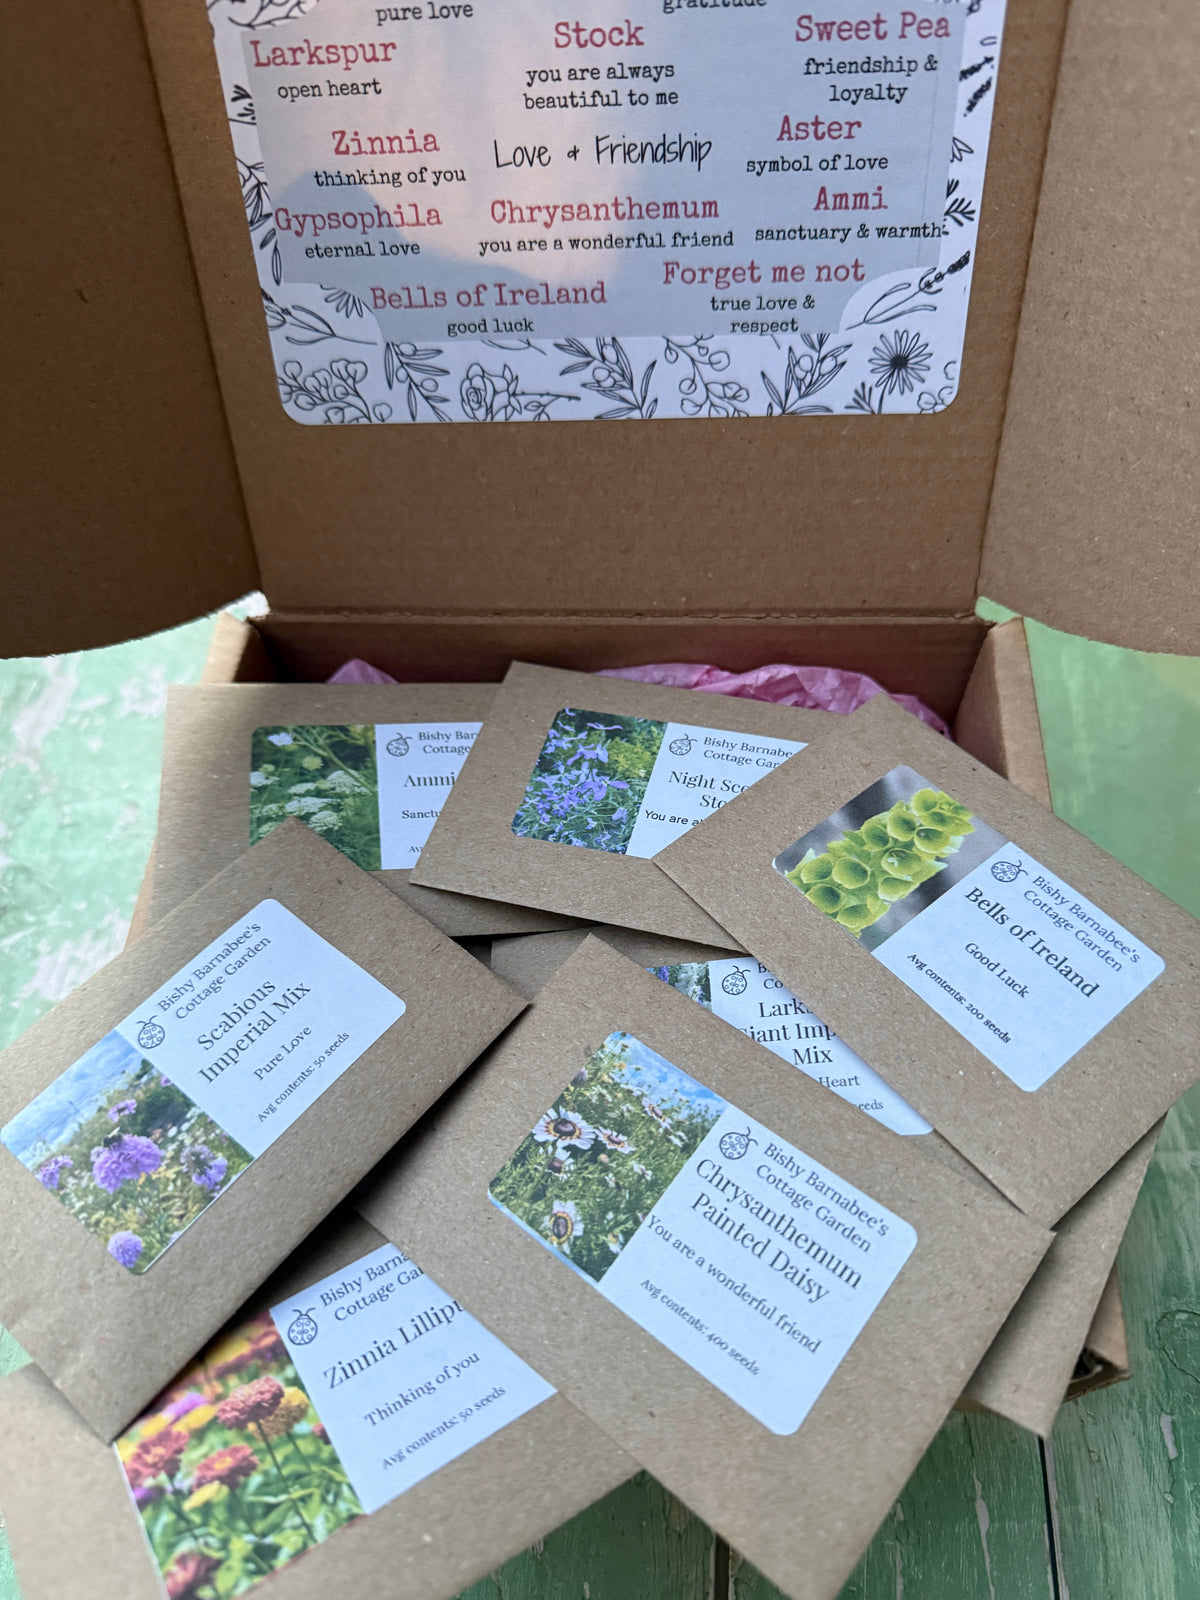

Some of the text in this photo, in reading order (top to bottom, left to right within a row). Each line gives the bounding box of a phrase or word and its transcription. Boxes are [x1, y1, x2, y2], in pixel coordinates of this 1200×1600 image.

[376, 2, 473, 25] pure love
[795, 11, 950, 42] Sweet Pea
[554, 20, 644, 49] Stock
[250, 39, 397, 70] Larkspur
[803, 55, 938, 76] friendship &
[277, 78, 382, 102] open heart
[525, 63, 675, 87] you are always
[524, 90, 679, 109] beautiful to me
[829, 84, 908, 104] loyalty
[332, 128, 440, 155] Zinnia
[776, 115, 862, 141] Aster
[493, 139, 551, 168] Love
[595, 133, 712, 171] Friendship
[746, 153, 889, 177] symbol of love
[314, 166, 466, 187] thinking of you
[491, 196, 720, 229] Chrysanthemum
[813, 185, 888, 212] Ammi
[274, 203, 443, 238] Gypsophila
[755, 222, 942, 243] sanctuary & warmth
[305, 241, 421, 259] eternal love
[478, 231, 734, 257] you are a wonderful friend
[662, 258, 865, 290] Forget me not
[370, 281, 607, 311] Bells of Ireland
[710, 295, 815, 311] true love &
[447, 317, 535, 336] good luck
[729, 318, 799, 335] respect
[419, 731, 451, 742] Bishy
[704, 737, 737, 750] Bishy
[704, 749, 752, 766] Cottage
[404, 772, 455, 787] Ammi
[668, 771, 715, 789] Night
[645, 810, 665, 821] You
[669, 815, 688, 824] are
[1023, 890, 1123, 972] Cottage Garden
[1032, 876, 1141, 963] Bishy Barnabee's
[964, 887, 1100, 998] Bells of Ireland
[157, 922, 261, 1012] Bishy Barnabee's
[175, 937, 271, 1019] Cottage Garden
[965, 942, 1029, 998] Good Luck
[907, 953, 1012, 1044] Avg contents: 200 seeds
[197, 981, 276, 1050] Scabious
[198, 982, 311, 1084] Imperial Mix
[253, 1027, 312, 1081] Pure Love
[792, 1046, 833, 1065] Mix
[258, 1031, 350, 1123] Avg contents: 50 seeds
[818, 1075, 861, 1088] Heart
[854, 1099, 884, 1110] eeds
[763, 1143, 890, 1237] Bishy Barnabee's
[756, 1164, 872, 1253] Cottage Garden
[696, 1159, 862, 1289] Chrysanthemum
[691, 1192, 830, 1304] Painted Daisy
[319, 1275, 363, 1308] Bishy
[647, 1215, 822, 1354] You are a wonderful friend
[334, 1282, 396, 1322] Cottage
[640, 1279, 760, 1376] Avg contents: 400 seeds
[323, 1336, 397, 1389] Zinnia
[363, 1351, 481, 1427] Thinking of you
[381, 1385, 506, 1470] Avg contents: 50 seeds
